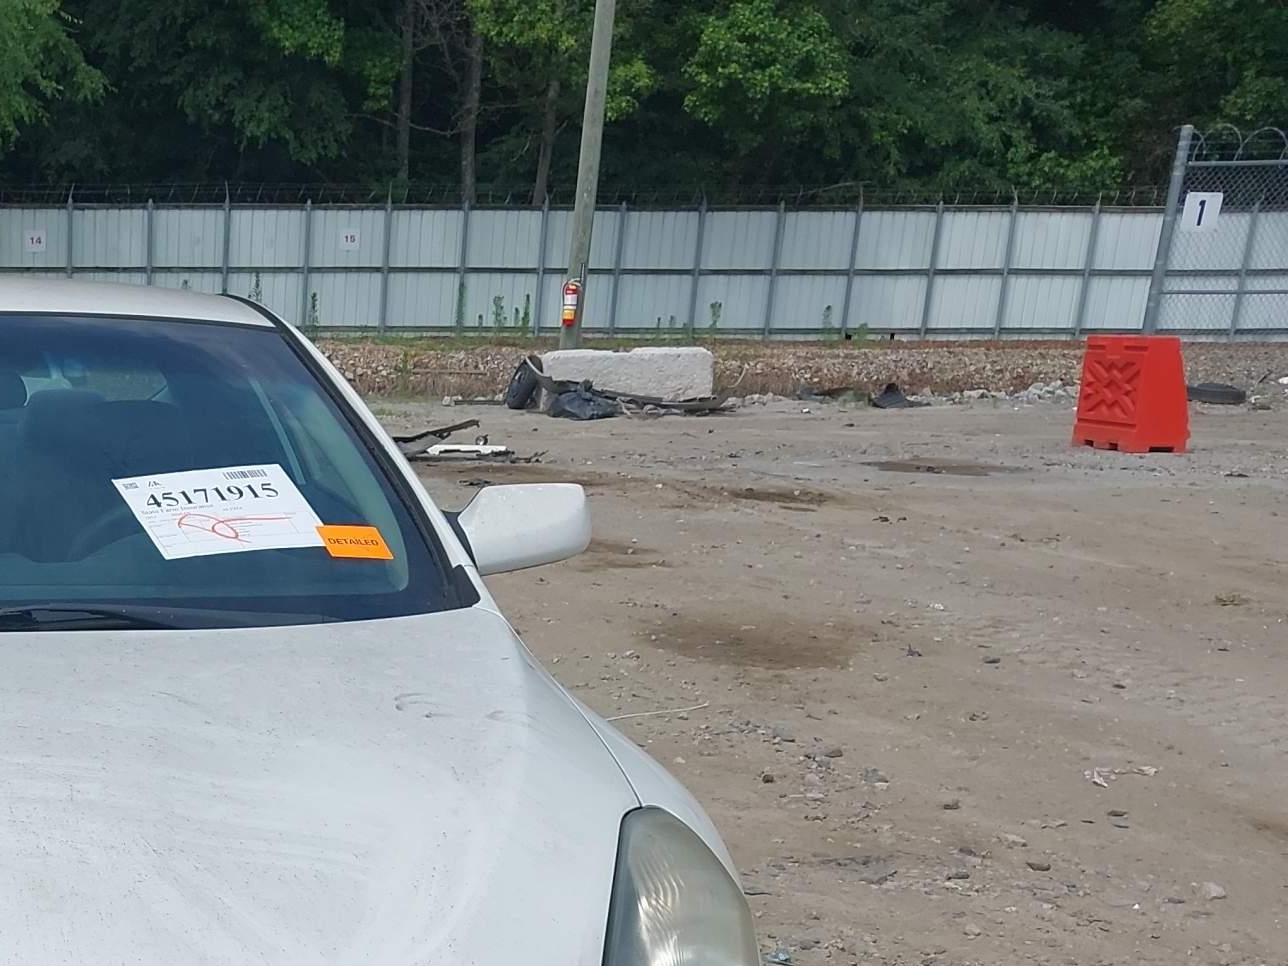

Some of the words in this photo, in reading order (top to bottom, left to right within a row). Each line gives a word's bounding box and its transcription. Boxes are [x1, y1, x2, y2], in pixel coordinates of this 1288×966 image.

[1196, 199, 1207, 227] 1
[30, 236, 42, 245] 14
[146, 483, 279, 508] 45171915
[327, 537, 379, 546] DETAILED
